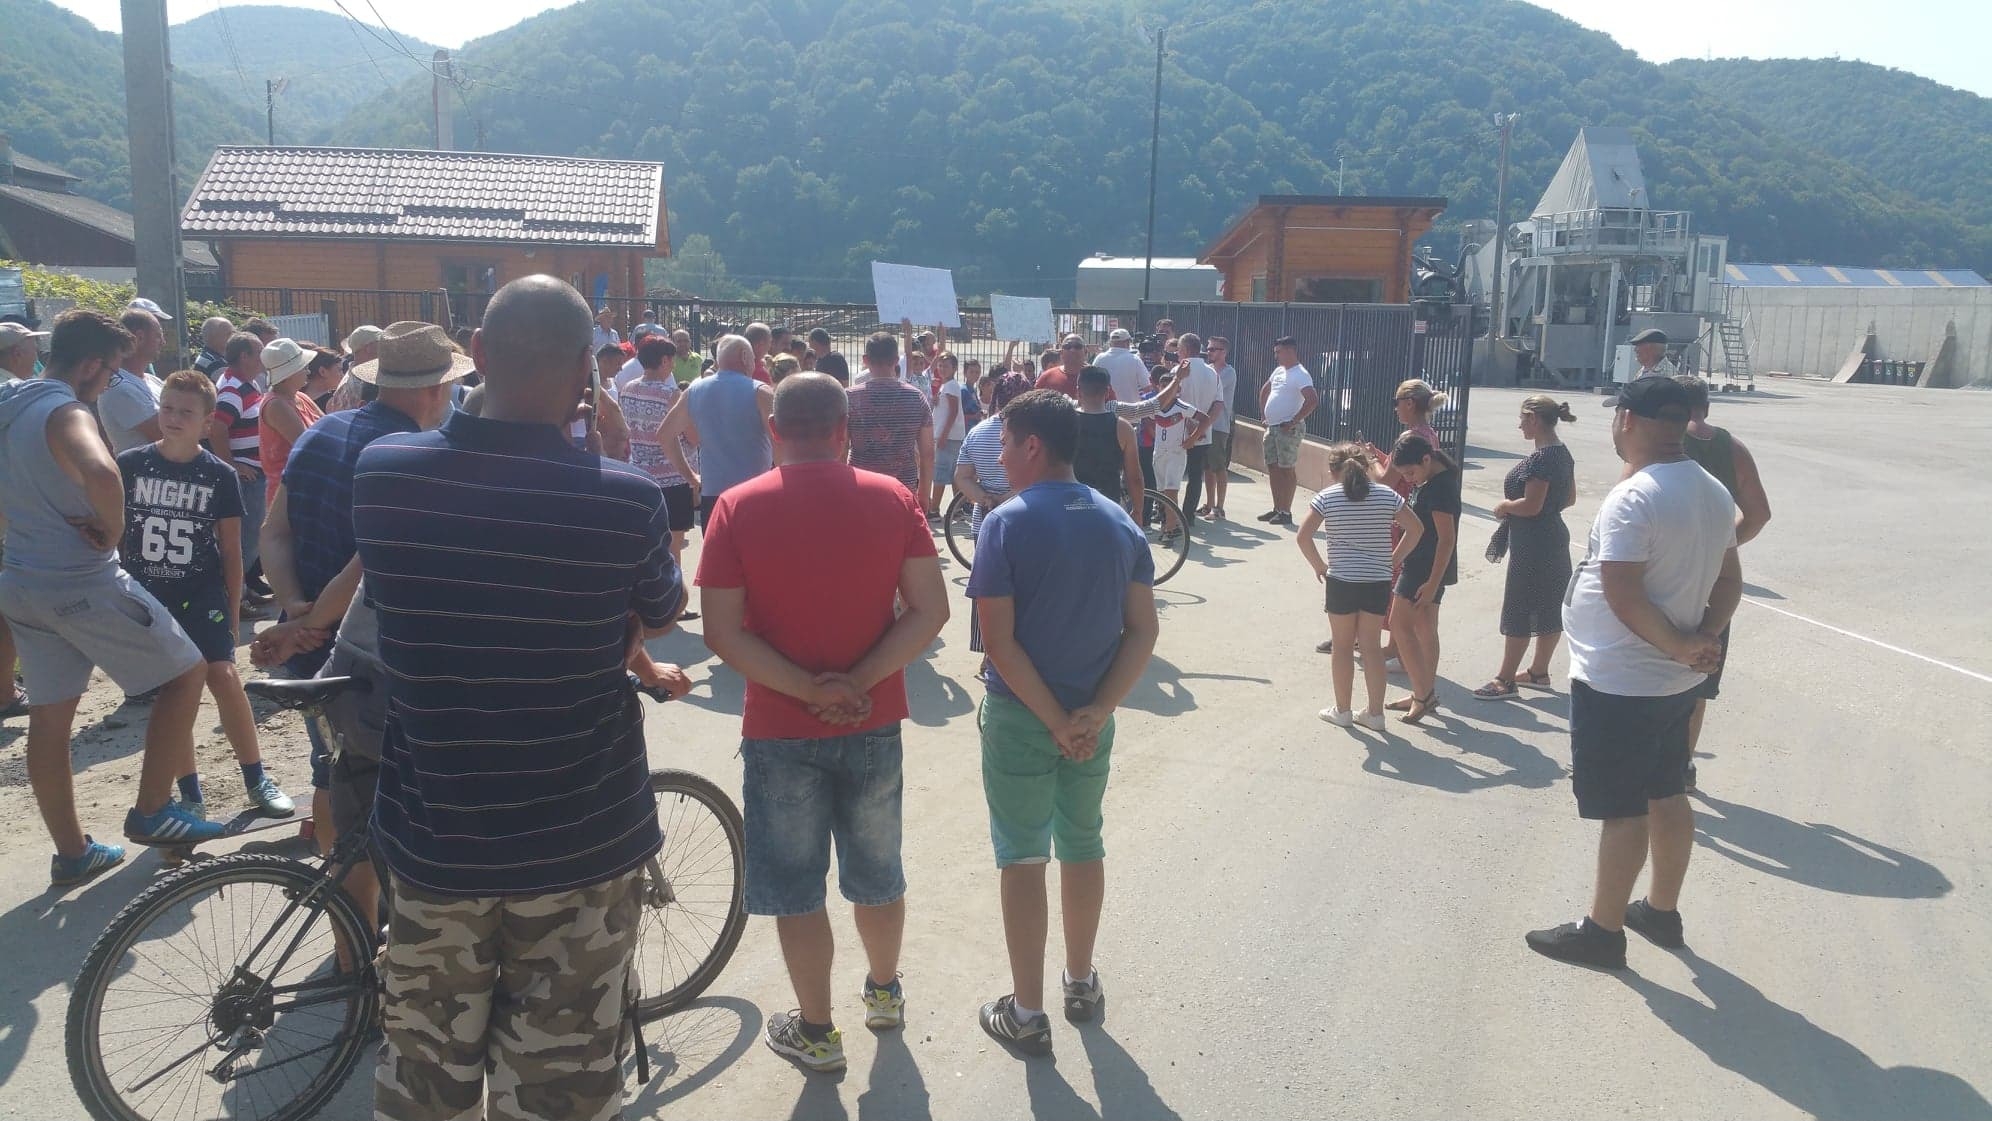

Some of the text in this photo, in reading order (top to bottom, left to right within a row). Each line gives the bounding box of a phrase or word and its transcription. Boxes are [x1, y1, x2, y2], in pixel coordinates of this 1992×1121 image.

[1161, 428, 1167, 441] 8
[134, 476, 214, 512] NIGHT
[141, 516, 194, 565] 65
